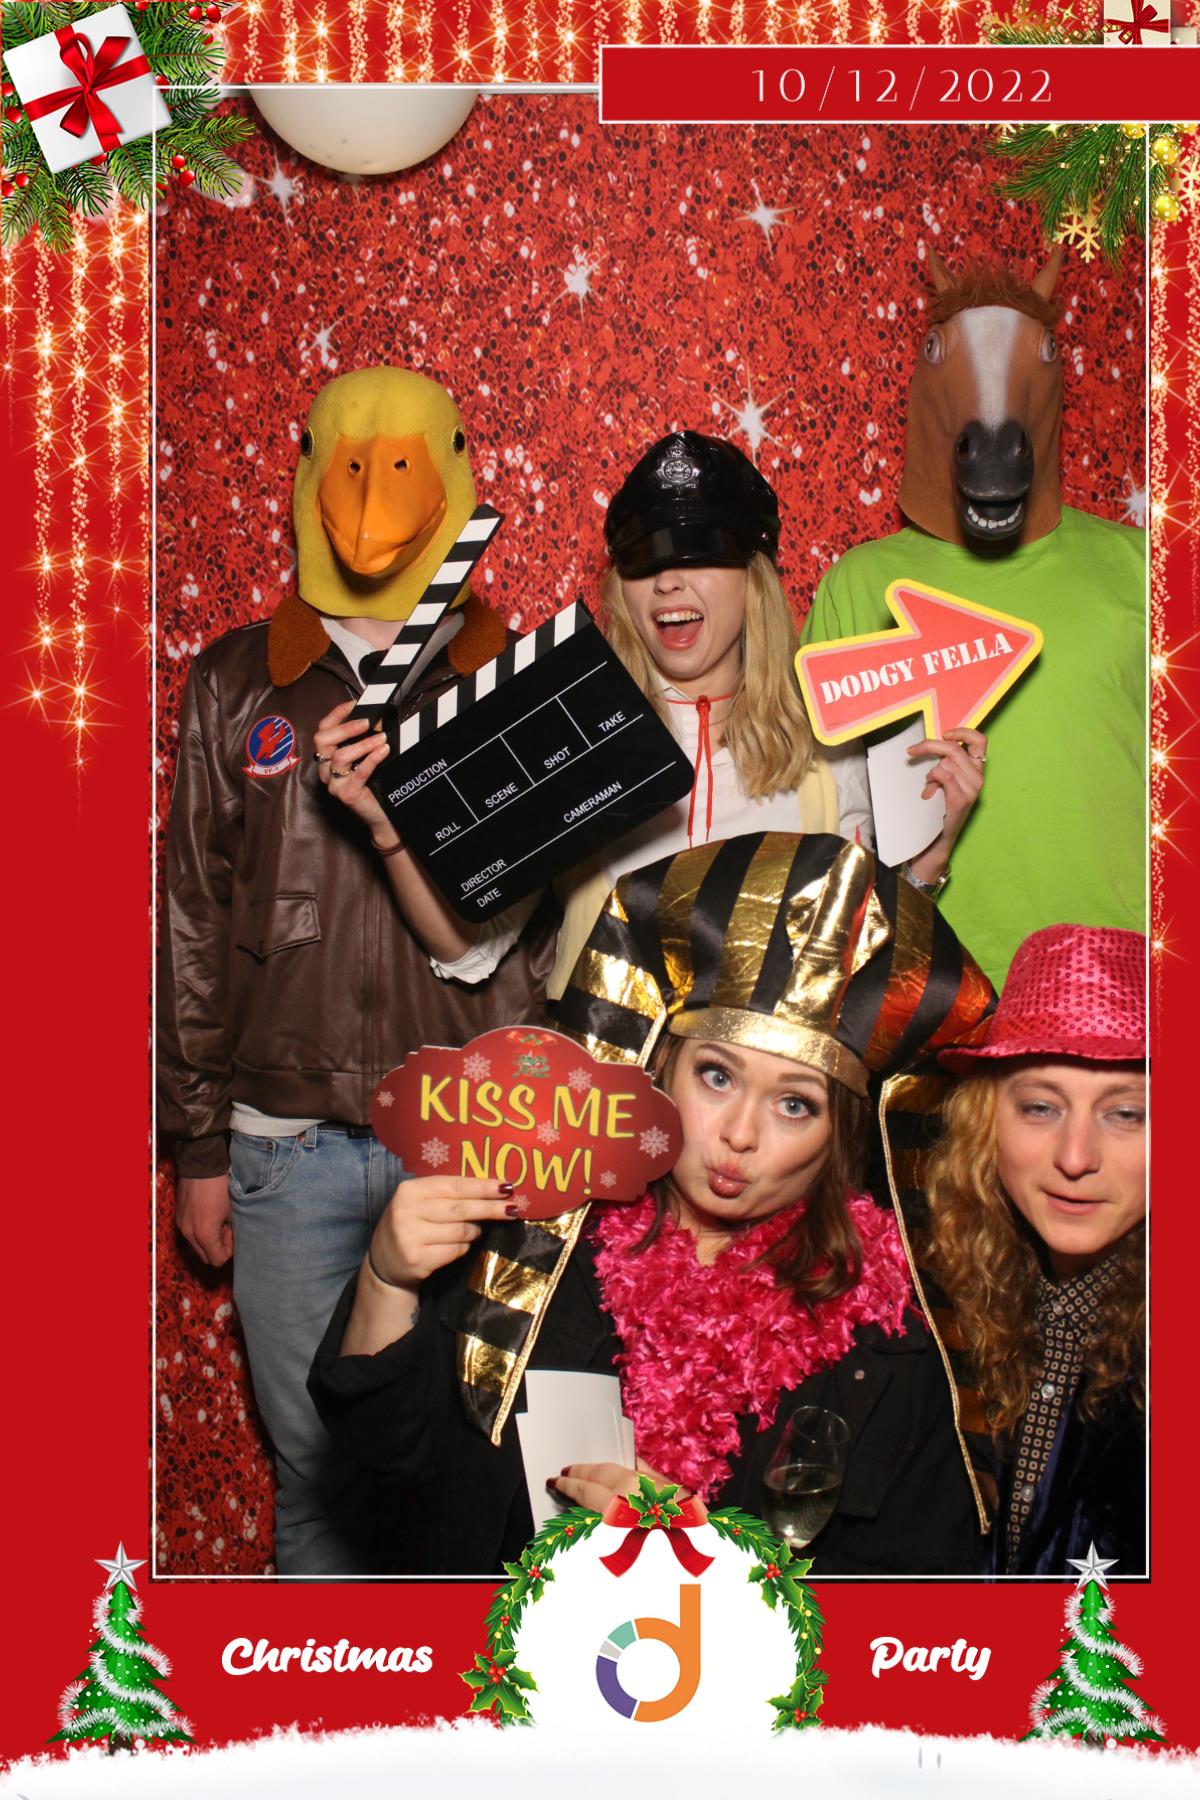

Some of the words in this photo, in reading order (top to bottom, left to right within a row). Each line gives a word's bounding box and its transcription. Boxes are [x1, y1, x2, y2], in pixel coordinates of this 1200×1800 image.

[820, 658, 915, 704] DODGY
[922, 632, 1014, 676] FELLA
[598, 711, 627, 733] TAKE
[543, 746, 572, 770] SHOT
[387, 758, 449, 805] PRODUCTION
[484, 782, 519, 809] SCENE
[562, 781, 623, 824] CAMERAMAN
[434, 821, 462, 842] ROLL
[460, 858, 507, 893] DIRECTOR
[476, 887, 502, 908] DATE
[420, 1073, 536, 1131] KISS
[552, 1085, 637, 1139] ME
[461, 1136, 594, 1195] NOW!
